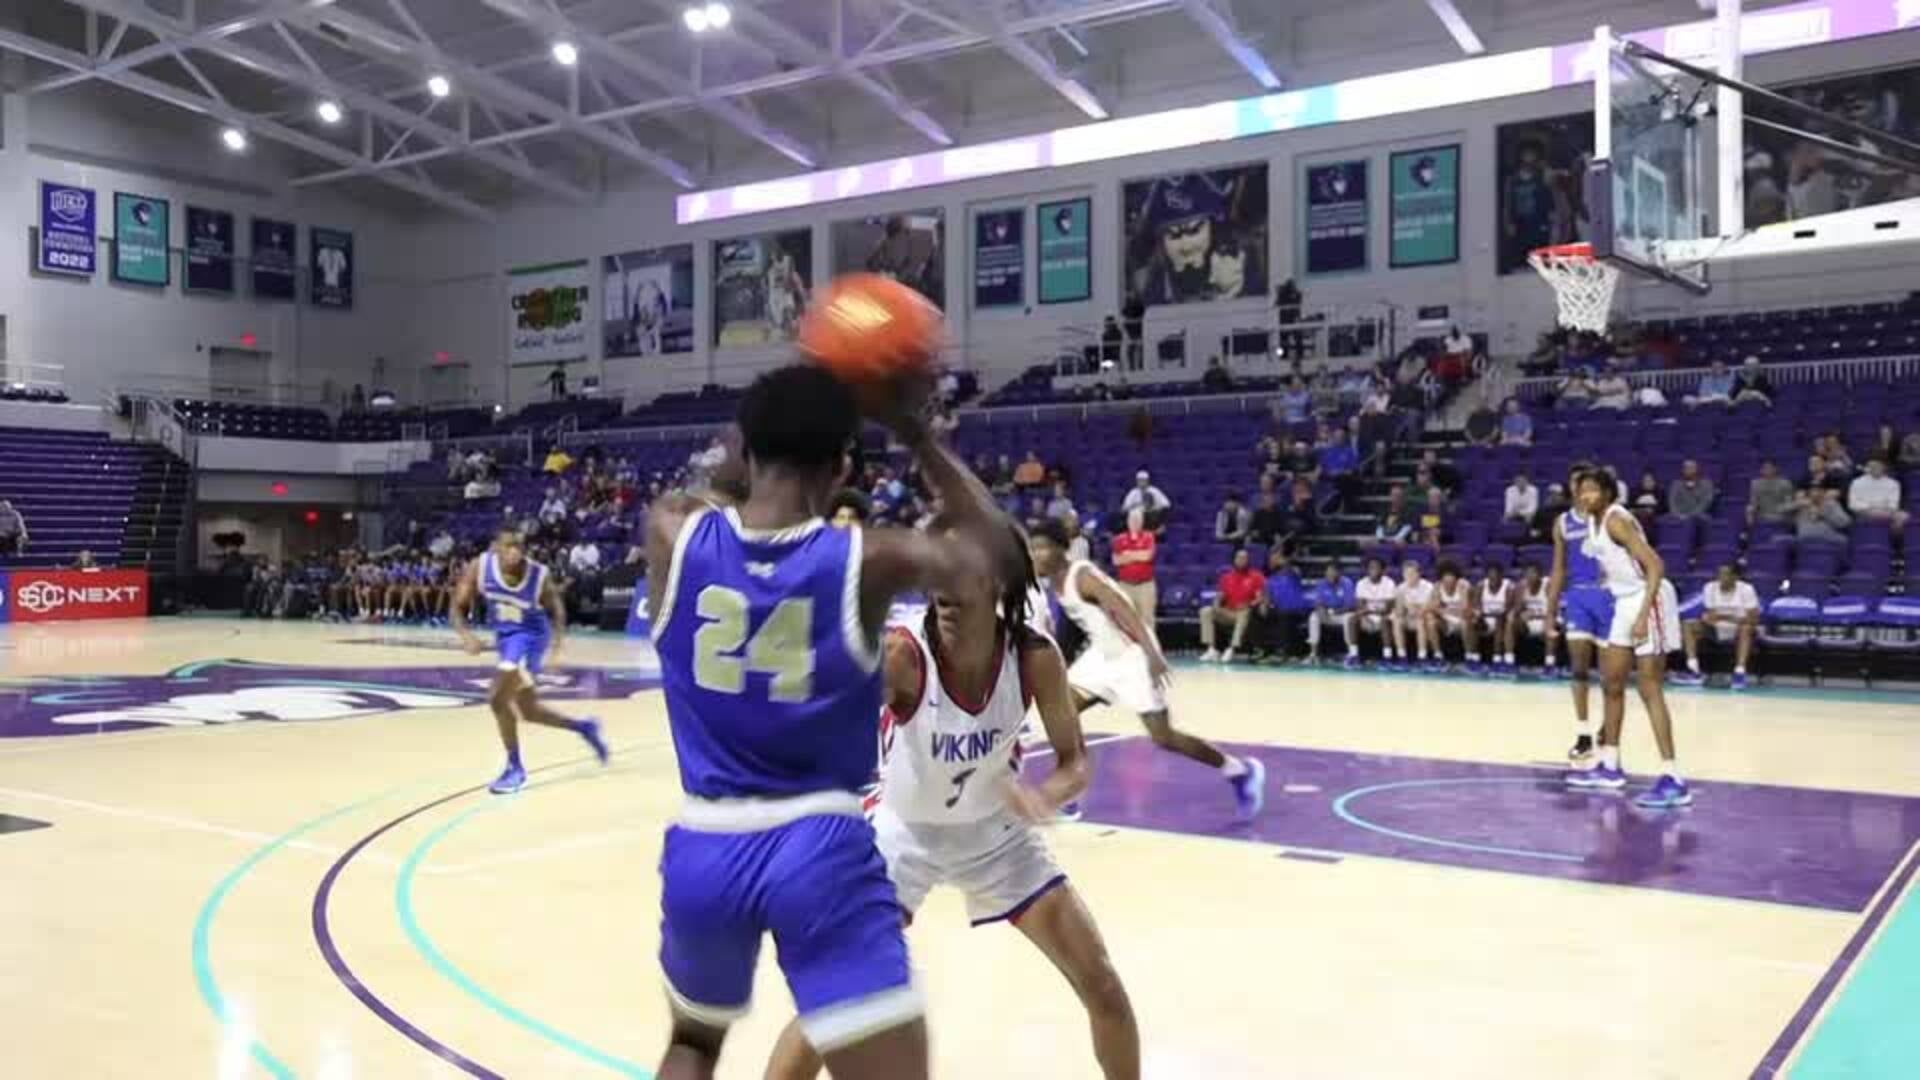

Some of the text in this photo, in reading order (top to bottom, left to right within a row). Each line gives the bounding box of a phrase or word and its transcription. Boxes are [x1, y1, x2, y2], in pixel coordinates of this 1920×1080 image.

[49, 251, 88, 269] 2022
[67, 586, 140, 603] NEXT
[692, 584, 817, 704] 24
